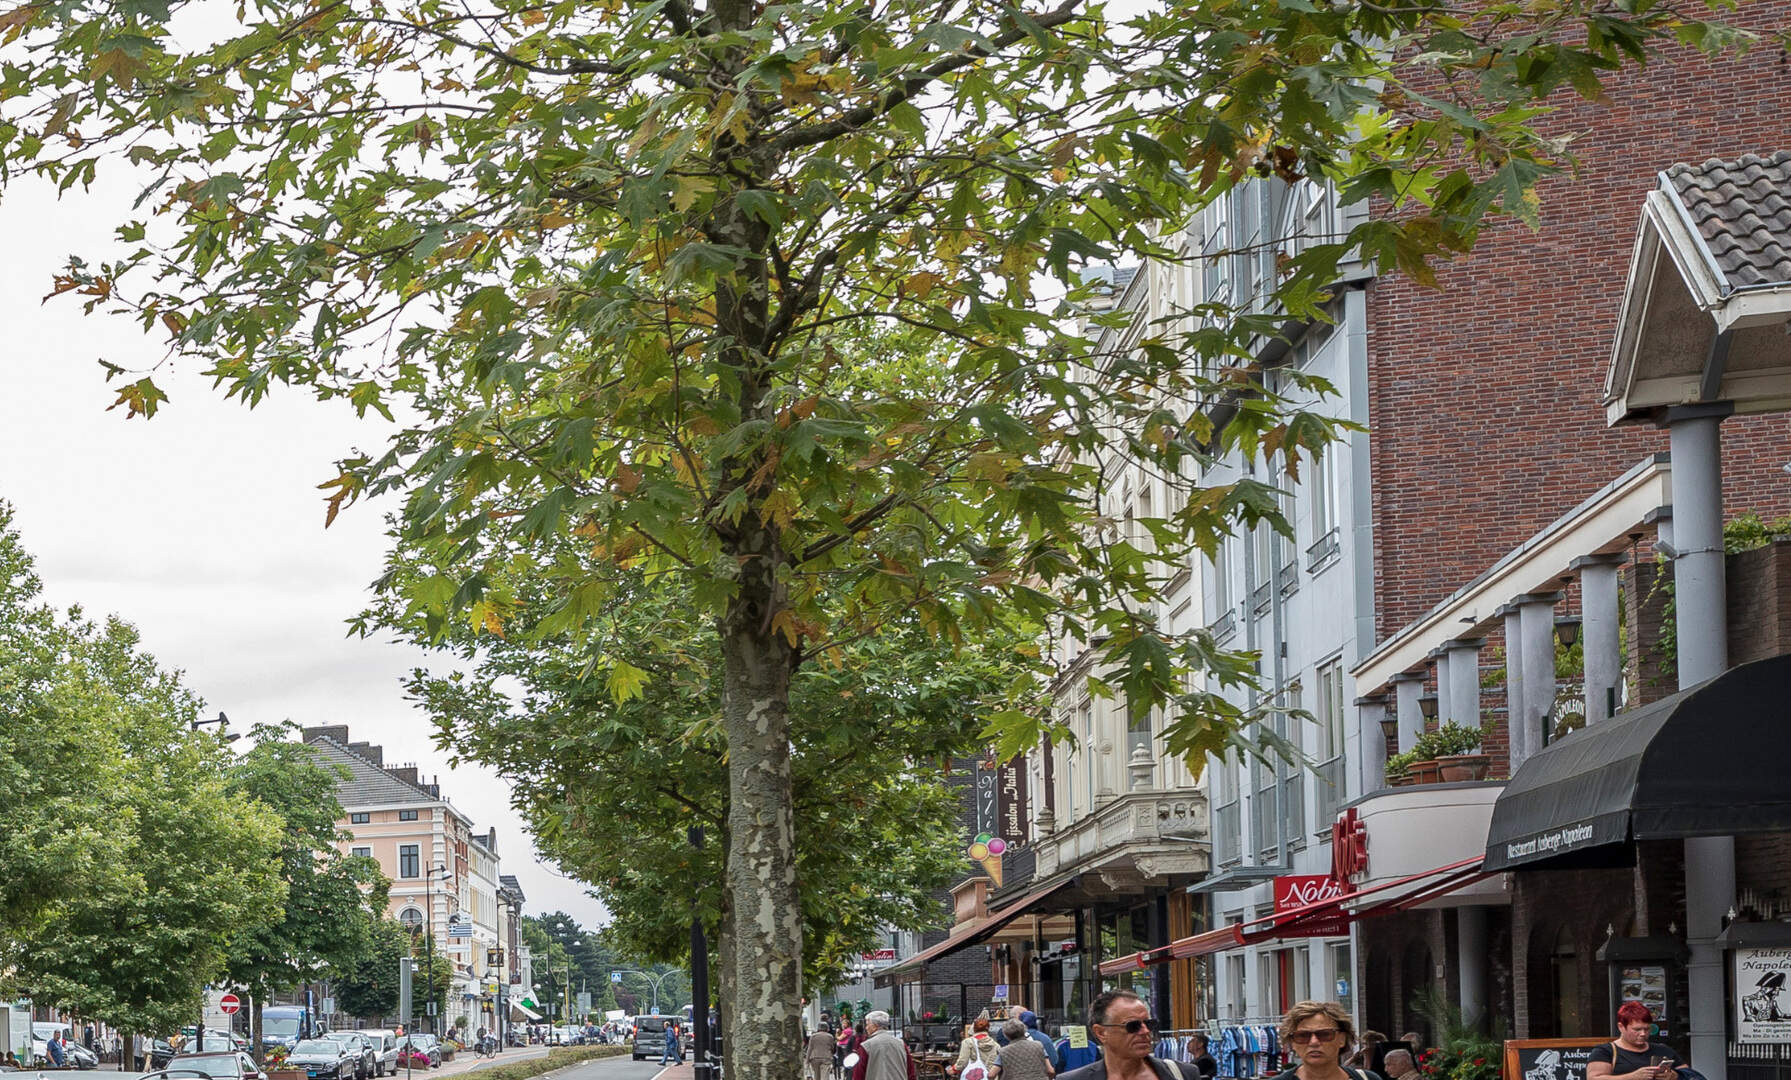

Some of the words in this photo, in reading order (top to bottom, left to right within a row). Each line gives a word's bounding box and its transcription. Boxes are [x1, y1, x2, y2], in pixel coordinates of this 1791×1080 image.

[1554, 699, 1585, 729] NAPOLEON
[1507, 839, 1537, 860] Restaurant
[1537, 833, 1561, 852] Auberge
[1561, 823, 1593, 848] Napoleon
